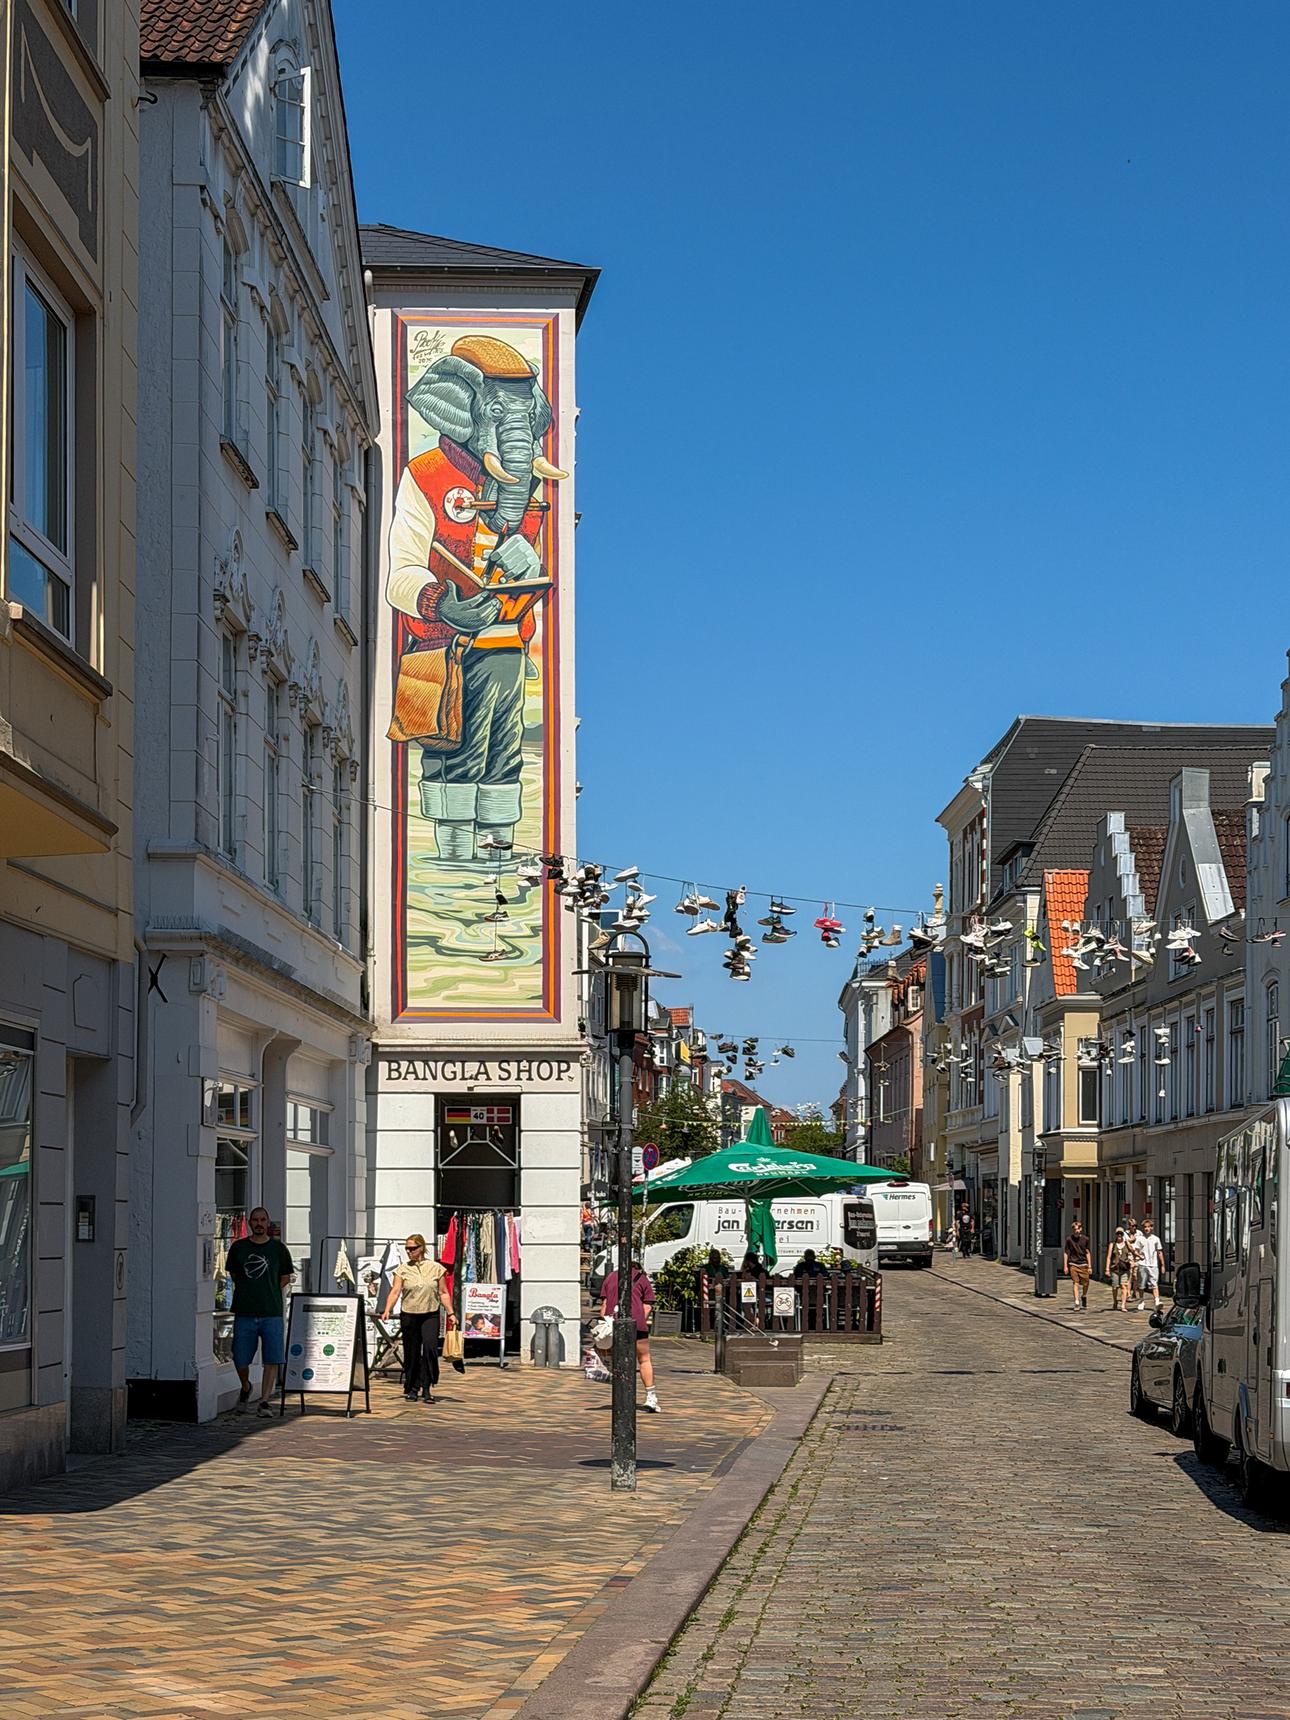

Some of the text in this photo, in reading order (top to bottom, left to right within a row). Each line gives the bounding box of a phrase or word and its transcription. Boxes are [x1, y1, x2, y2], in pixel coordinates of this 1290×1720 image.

[385, 1060, 571, 1081] BANGLA SHOP
[473, 1112, 485, 1120] 40
[714, 1216, 740, 1234] jan
